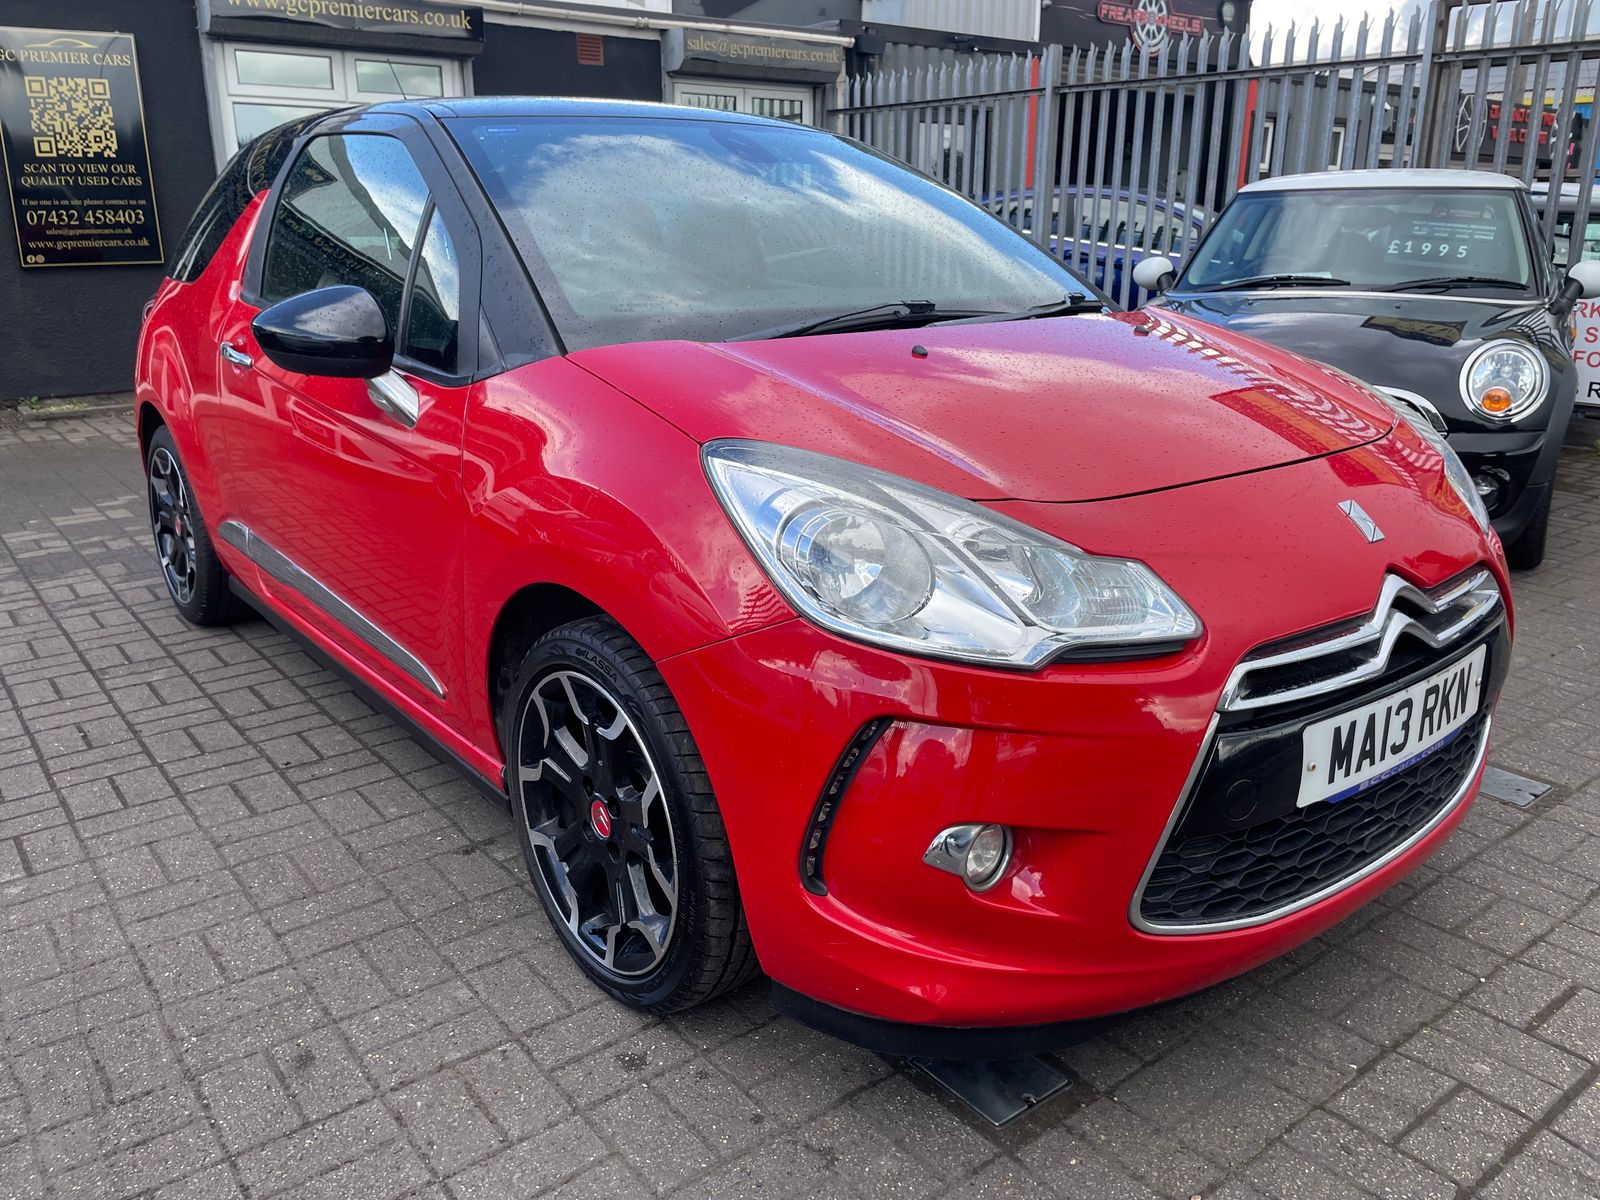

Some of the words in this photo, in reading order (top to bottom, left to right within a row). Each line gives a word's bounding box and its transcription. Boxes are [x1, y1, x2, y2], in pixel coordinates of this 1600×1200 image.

[20, 50, 90, 64] PREMIER
[93, 53, 131, 66] CARS
[687, 36, 840, 63] sales@gcpremiercars.co.uk
[24, 164, 56, 173] SCAN
[59, 164, 76, 173] TO
[78, 164, 109, 173] VIEW
[111, 164, 137, 174] OUR
[21, 176, 75, 187] QUALITY
[78, 176, 109, 186] USED
[111, 176, 143, 186] CARS
[26, 210, 79, 226] 07432
[84, 209, 145, 225] 458403
[28, 237, 150, 250] www.gcpremiercars.co.uk
[1387, 240, 1468, 258] £1995
[584, 649, 618, 683] LASSA
[1327, 698, 1414, 785] MA13
[1417, 662, 1473, 743] RKN
